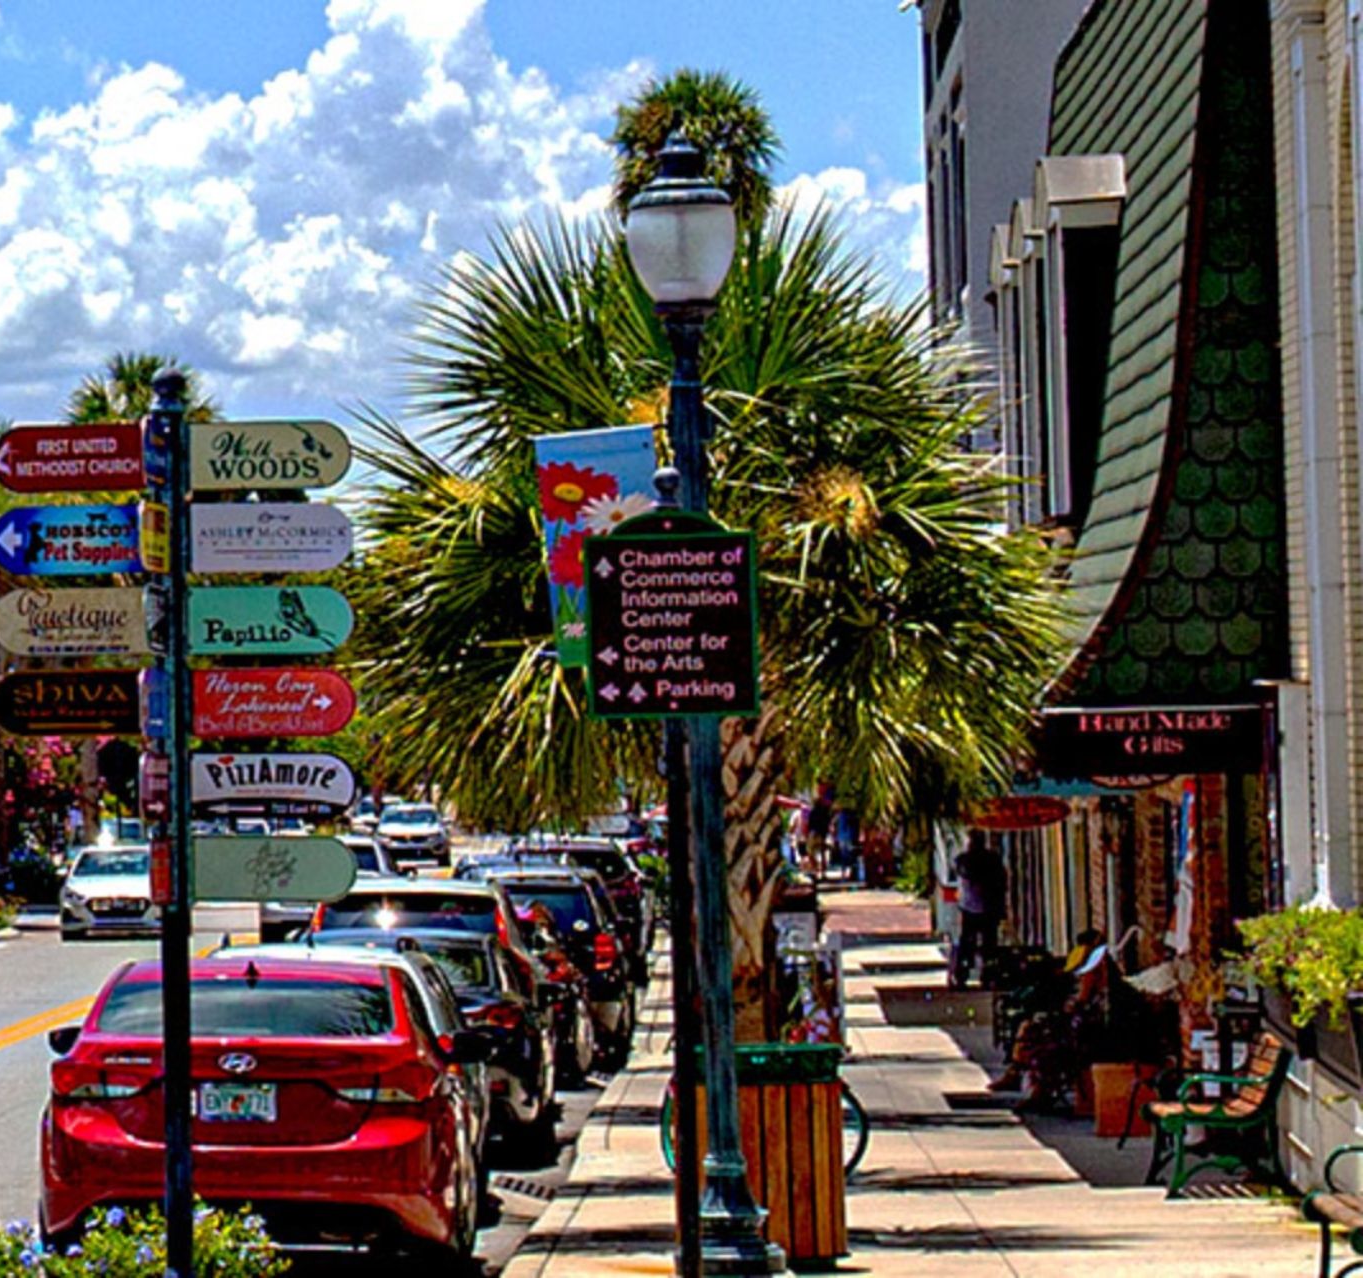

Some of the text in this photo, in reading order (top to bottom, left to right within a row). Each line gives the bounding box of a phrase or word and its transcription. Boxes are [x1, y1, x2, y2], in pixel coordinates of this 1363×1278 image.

[36, 437, 118, 455] FIRST UNITED
[15, 458, 140, 477] METHODIST CHURCH
[209, 457, 321, 481] WOODS
[199, 526, 256, 538] ASHLEY
[44, 541, 138, 565] Pet Supplies
[619, 547, 743, 569] Chamber of
[620, 569, 735, 588] Commerce
[621, 589, 739, 608] Information
[621, 610, 693, 628] Center
[202, 617, 293, 647] Papilio
[623, 632, 730, 652] Center for
[624, 653, 706, 673] the Arts
[656, 679, 736, 700] Parking
[1078, 710, 1232, 732] Hand Made
[1123, 734, 1186, 754] Gifts
[205, 757, 340, 789] PizzAmore
